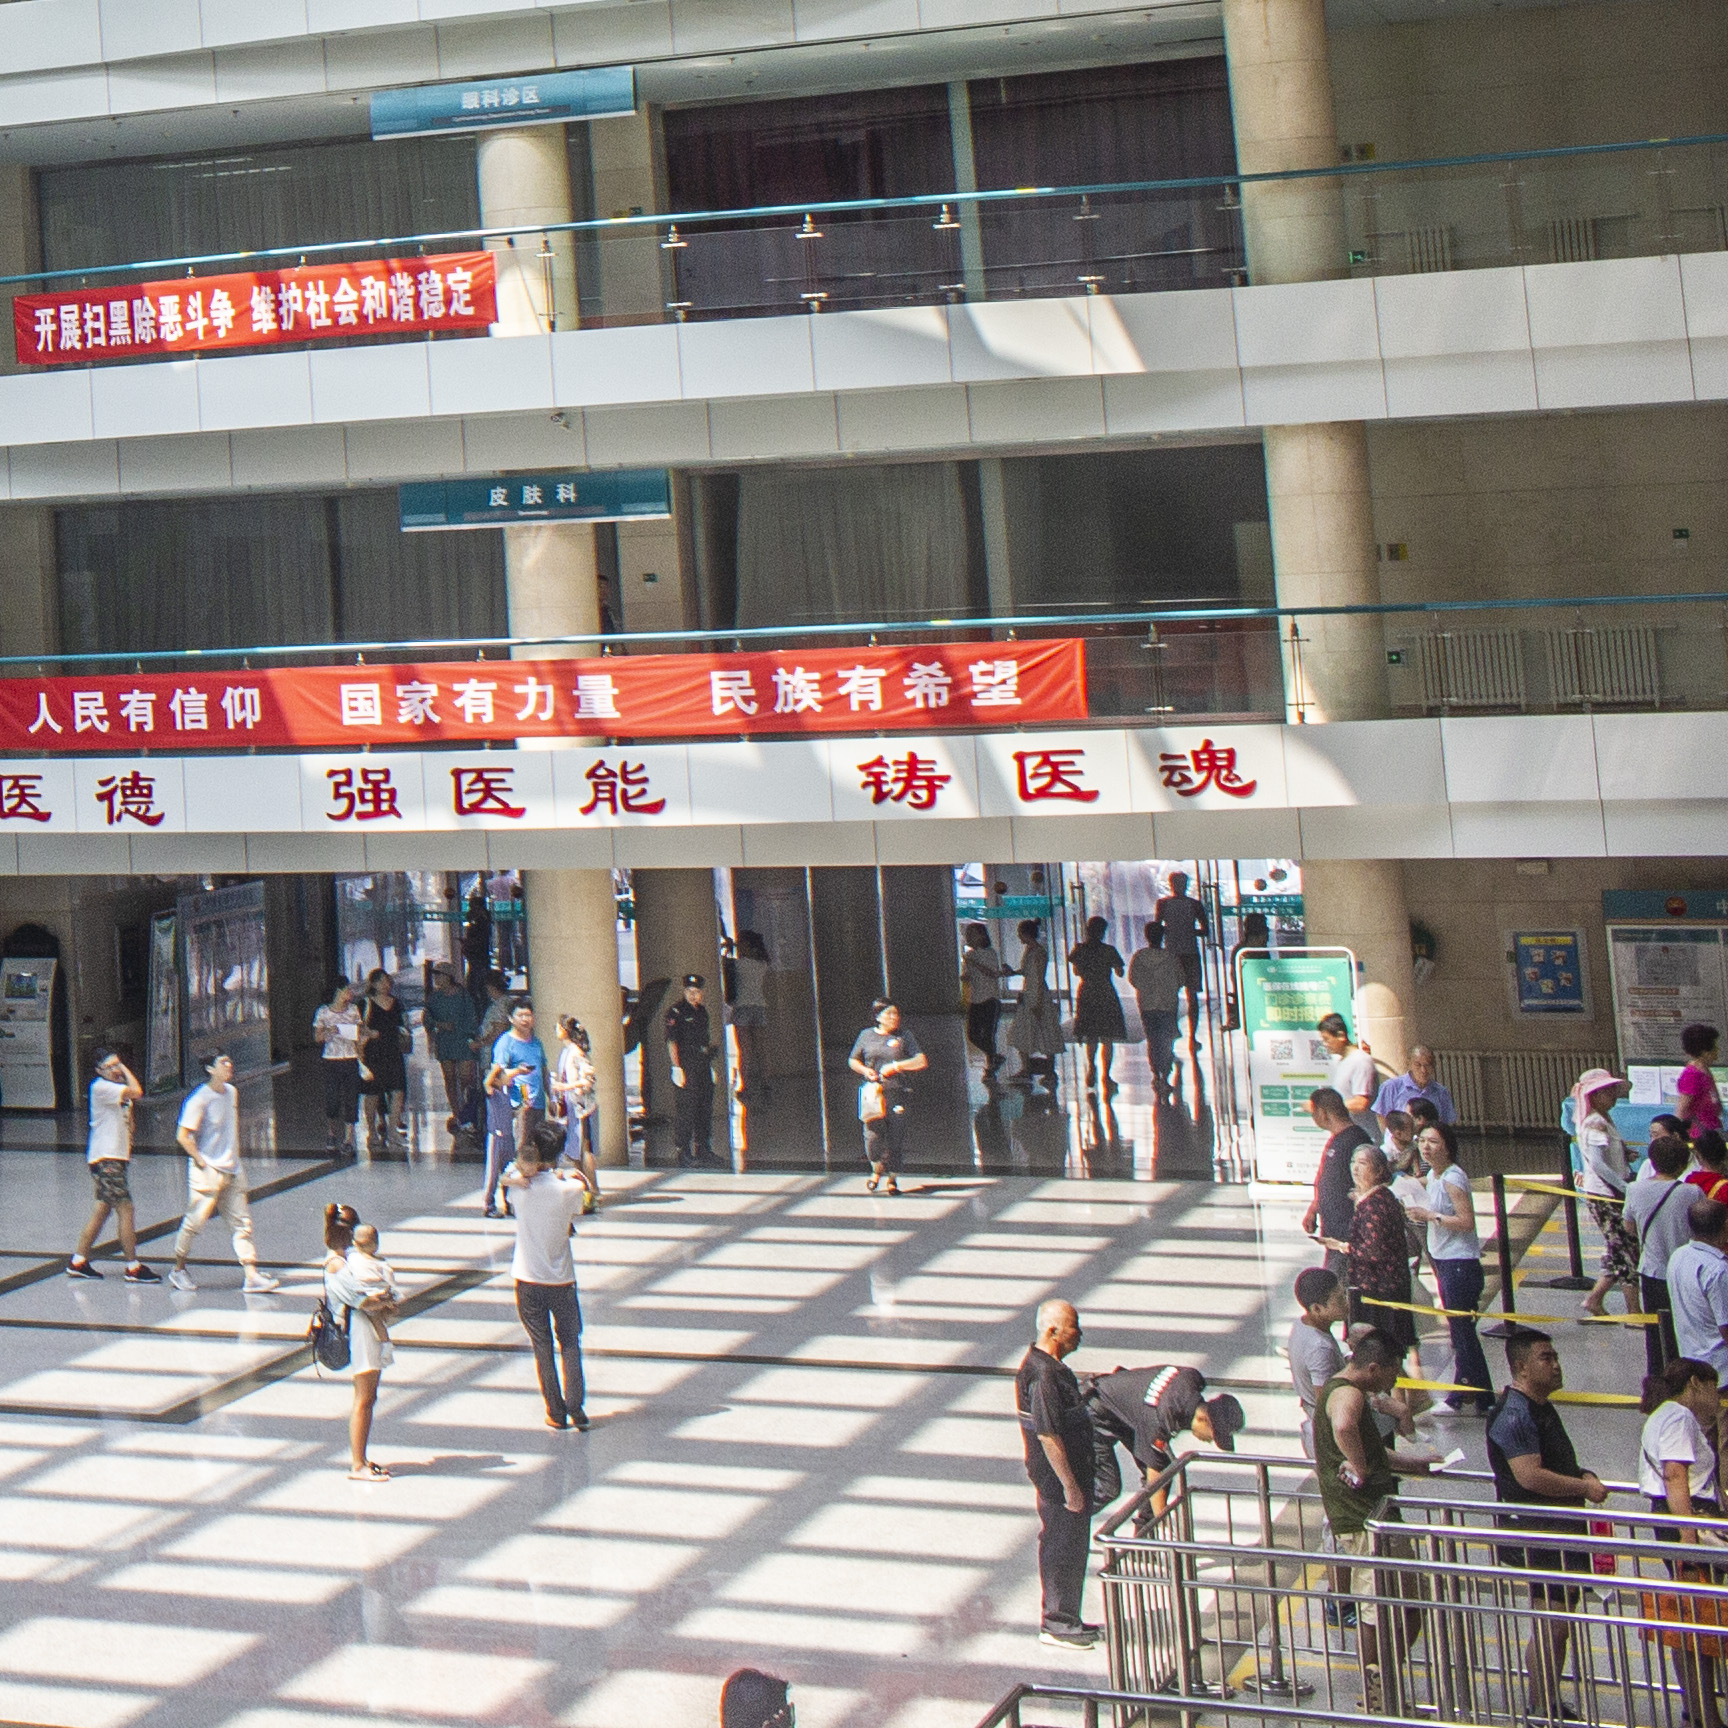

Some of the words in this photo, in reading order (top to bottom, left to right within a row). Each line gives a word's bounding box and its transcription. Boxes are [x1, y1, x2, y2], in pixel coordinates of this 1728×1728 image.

[462, 86, 540, 109] 眼科诊区
[34, 286, 234, 353] 开展扫黑除恶斗争
[250, 269, 475, 334] 维护社会和谐稳定
[489, 482, 576, 506] 皮肤科
[27, 687, 262, 735] 人民有信仰
[340, 675, 620, 728] 国家有力量
[711, 660, 1022, 717] 民族有希望
[326, 760, 666, 821] 强医能
[858, 738, 1258, 809] 铸医魂
